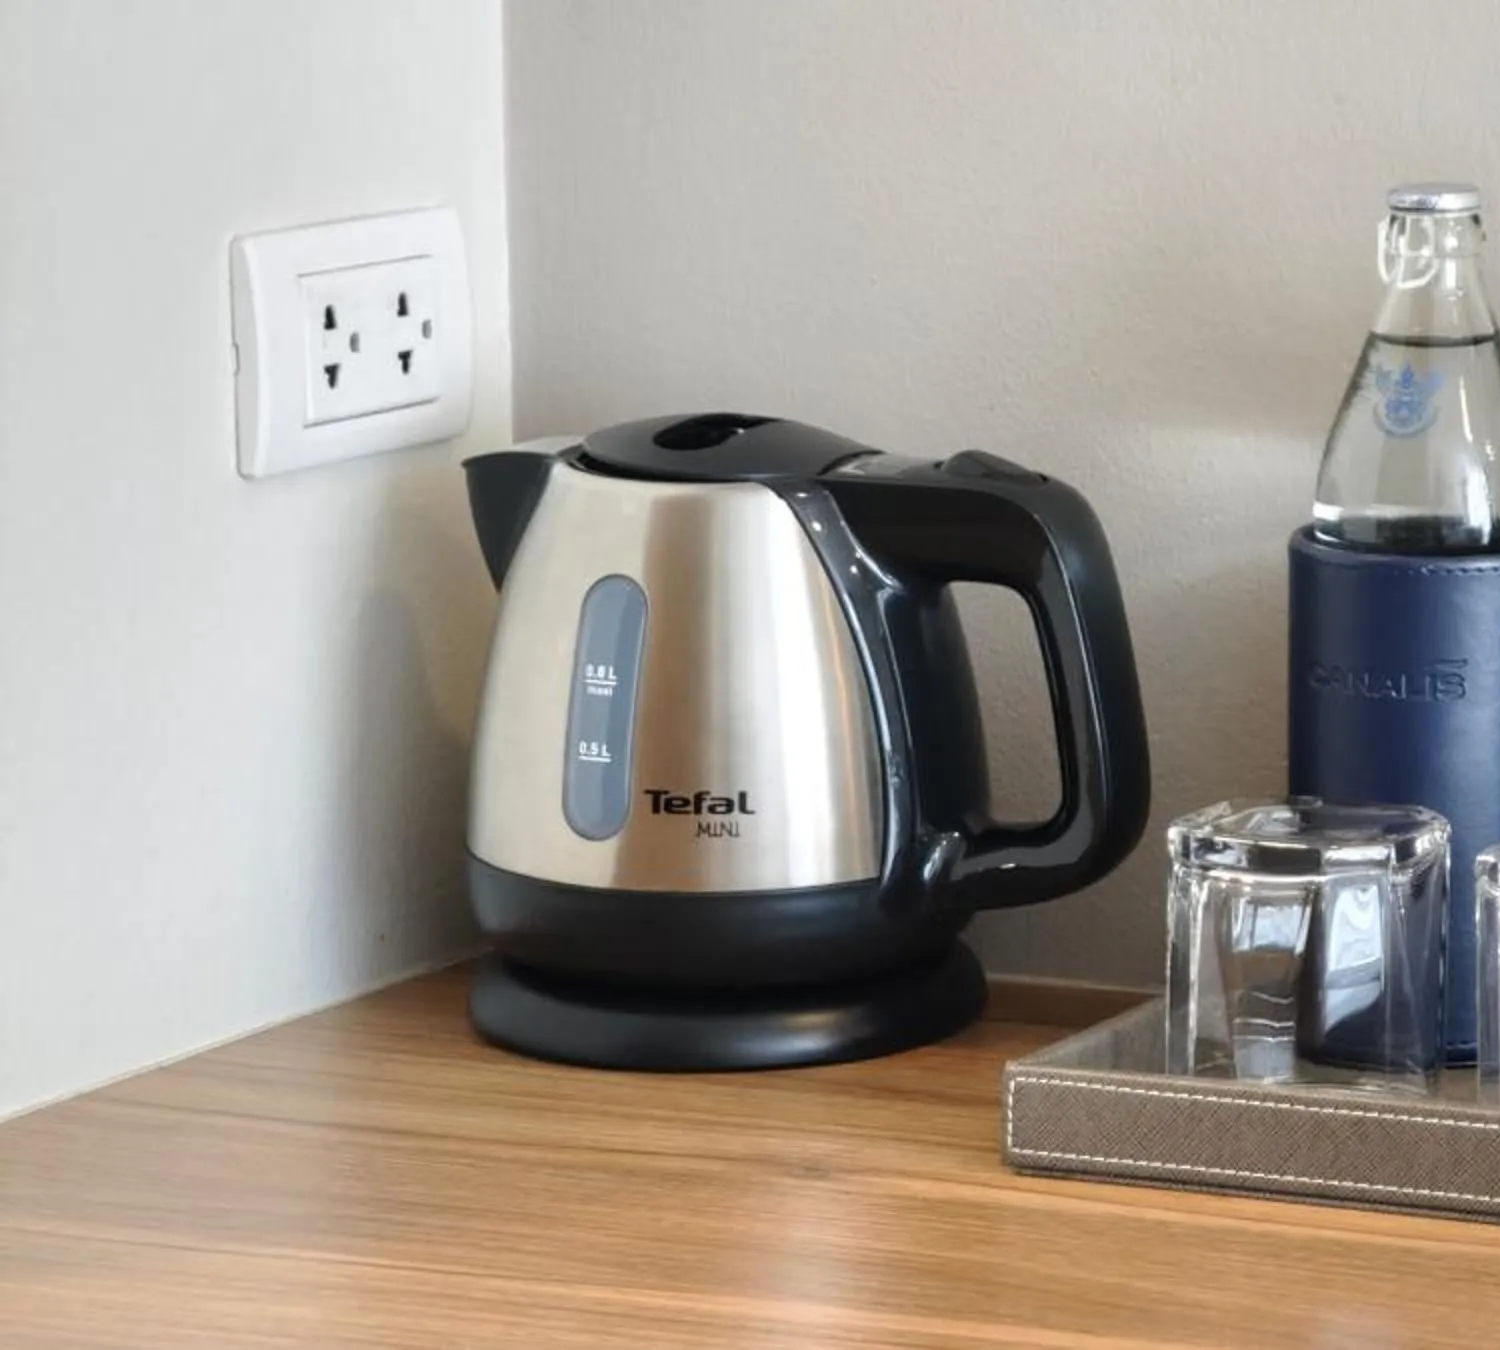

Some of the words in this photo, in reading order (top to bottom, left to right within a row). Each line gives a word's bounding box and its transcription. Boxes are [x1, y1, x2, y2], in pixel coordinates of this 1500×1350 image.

[579, 740, 599, 756] 0.5
[601, 743, 612, 757] L
[643, 789, 756, 815] Tefal
[695, 820, 741, 838] MINI
